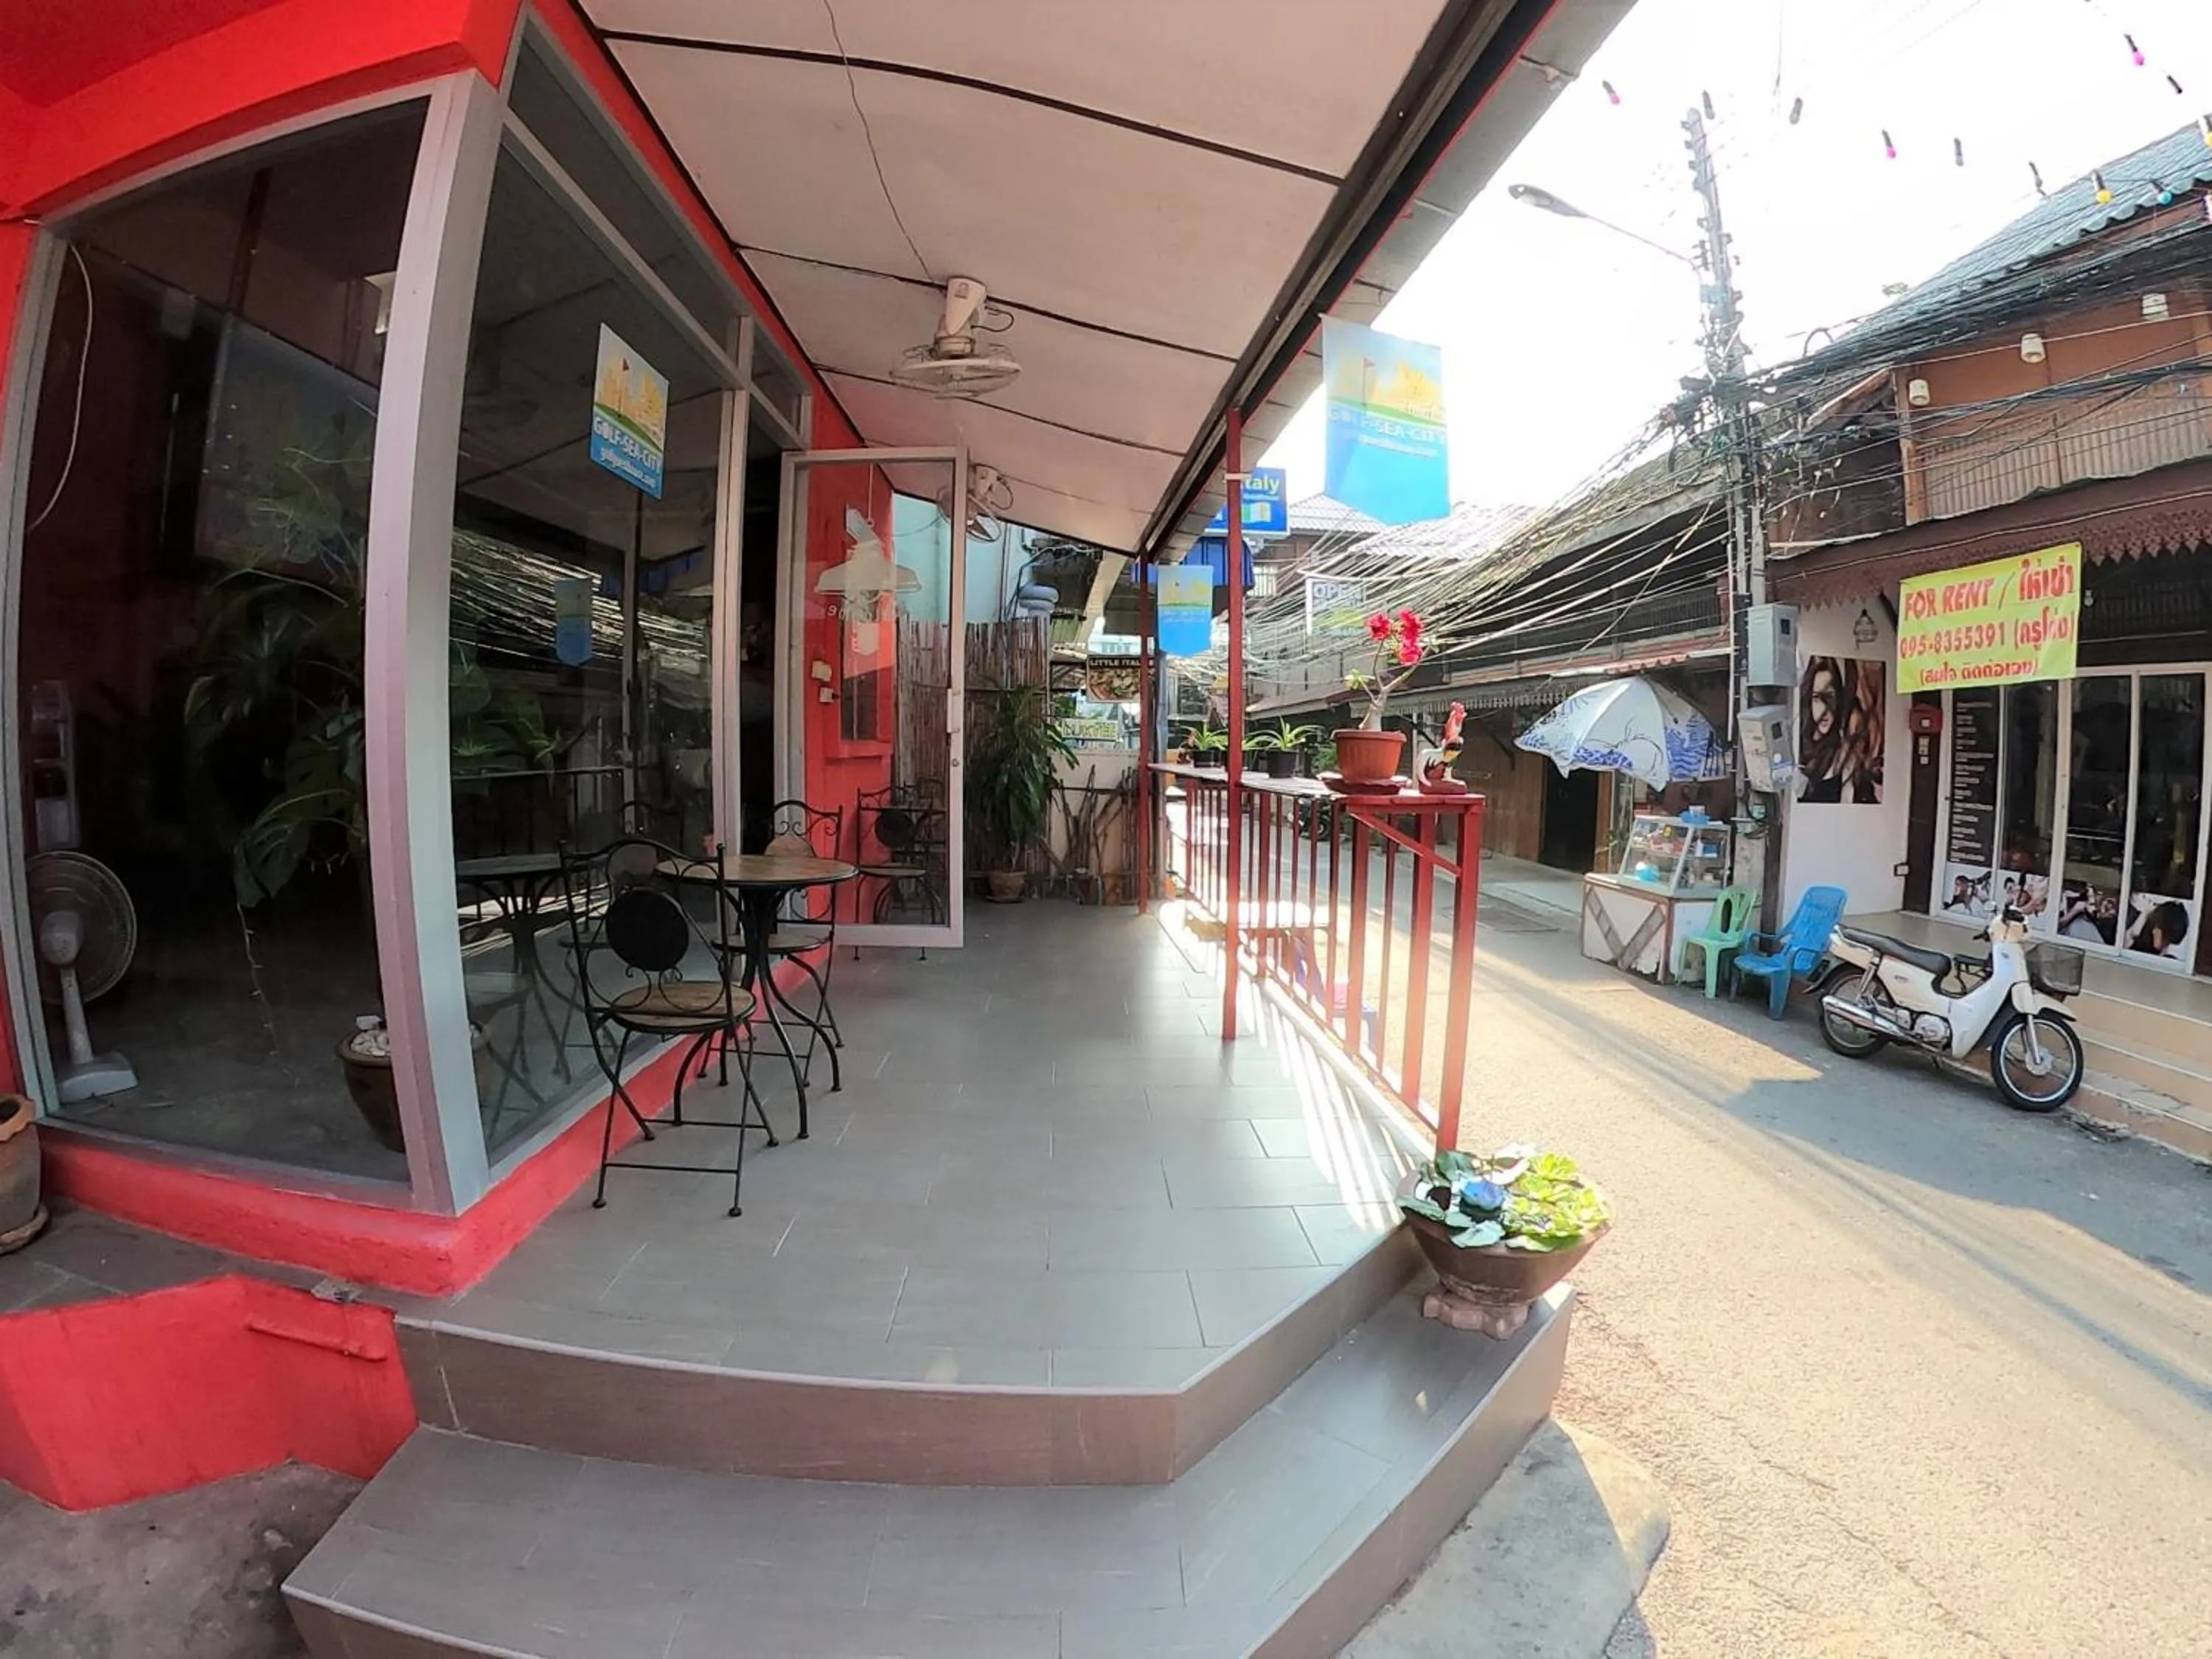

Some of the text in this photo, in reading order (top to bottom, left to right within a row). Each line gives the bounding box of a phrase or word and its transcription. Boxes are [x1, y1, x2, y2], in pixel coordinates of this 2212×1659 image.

[1243, 474, 1280, 495] taly
[1905, 588, 1938, 622] FOR
[1943, 577, 1995, 614] RENT
[1900, 622, 2005, 659] 095-8355391
[1090, 658, 1119, 667] LITTLE
